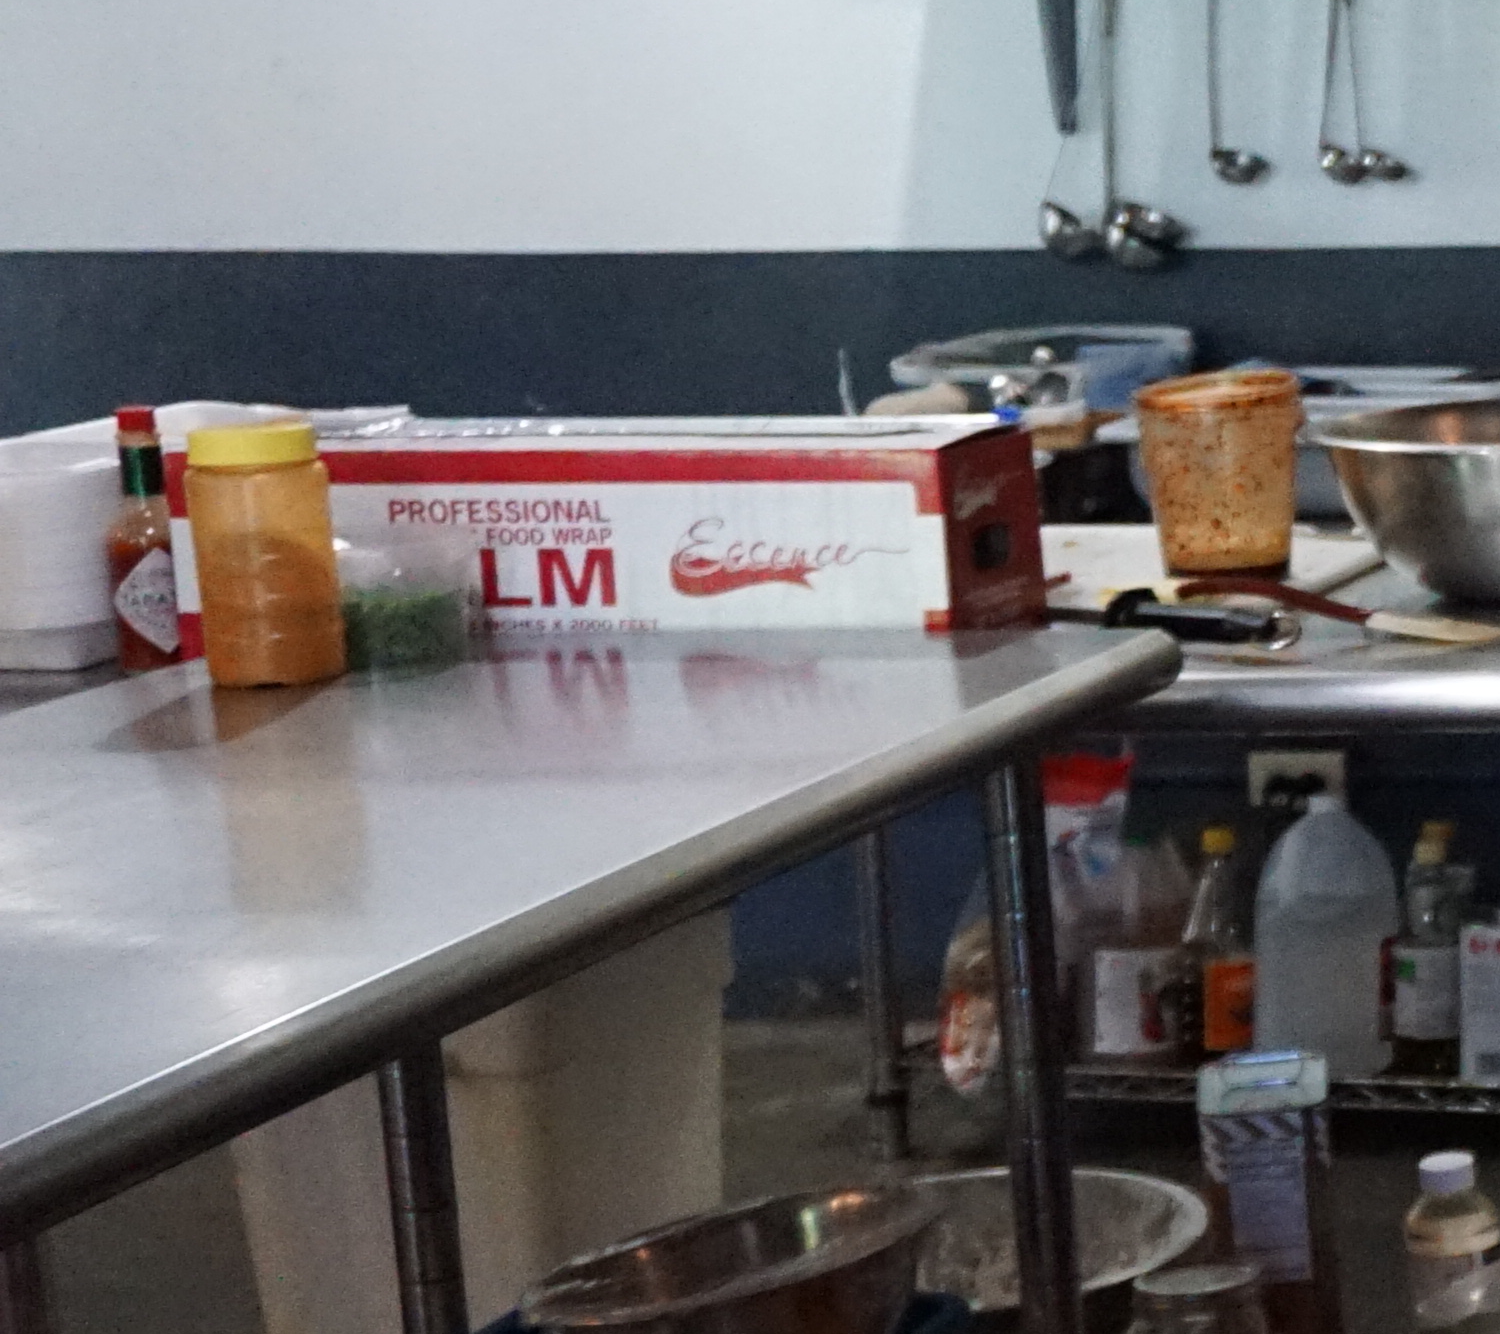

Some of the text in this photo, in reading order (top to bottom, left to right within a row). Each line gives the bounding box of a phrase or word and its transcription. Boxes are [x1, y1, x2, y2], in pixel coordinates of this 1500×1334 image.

[387, 498, 611, 525] PROFESSIONAL
[485, 528, 612, 547] FOOD WRAP
[479, 548, 618, 608] LM
